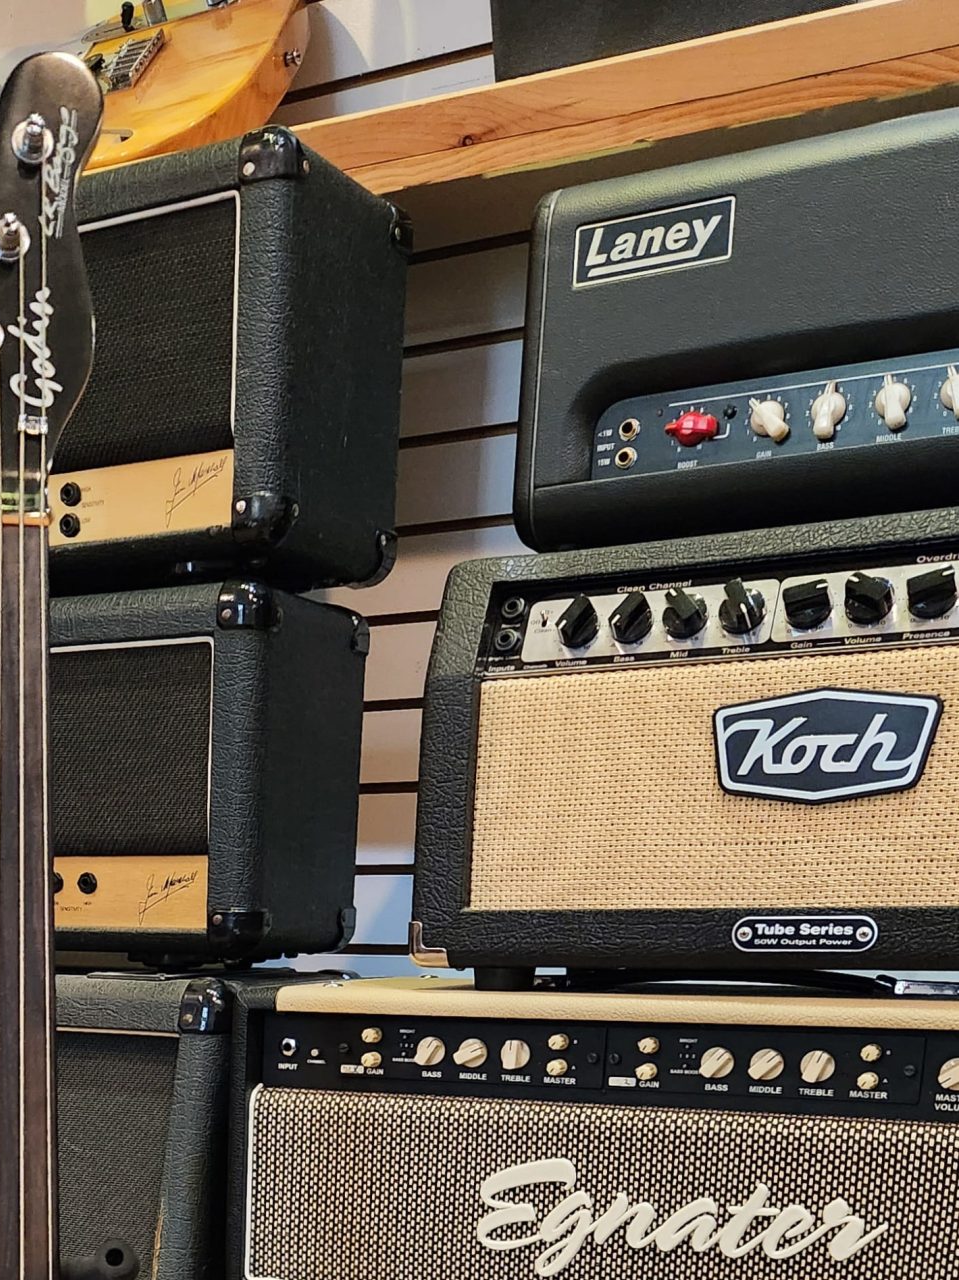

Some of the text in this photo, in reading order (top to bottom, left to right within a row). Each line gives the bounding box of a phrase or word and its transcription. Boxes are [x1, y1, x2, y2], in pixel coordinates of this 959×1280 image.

[585, 215, 722, 277] Laney
[7, 286, 63, 408] Godin
[876, 433, 902, 442] MIDDLE
[816, 442, 834, 450] BASS
[756, 450, 772, 458] GAIN
[677, 460, 698, 469] BOOST
[649, 580, 692, 591] Channel
[844, 636, 882, 644] Volume
[902, 631, 950, 640] Presence
[722, 646, 750, 654] Treble
[555, 659, 587, 667] Volume
[726, 713, 916, 776] Koch
[754, 923, 854, 935] Tube Series
[780, 938, 816, 946] Output
[459, 1072, 487, 1080] MIDDLE
[501, 1074, 530, 1082] TREBLE
[543, 1077, 576, 1085] MASTER
[749, 1086, 782, 1094] MIDDLE
[798, 1088, 835, 1097] TREBLE
[849, 1090, 888, 1099] MASTER
[476, 1158, 889, 1278] Egnater
